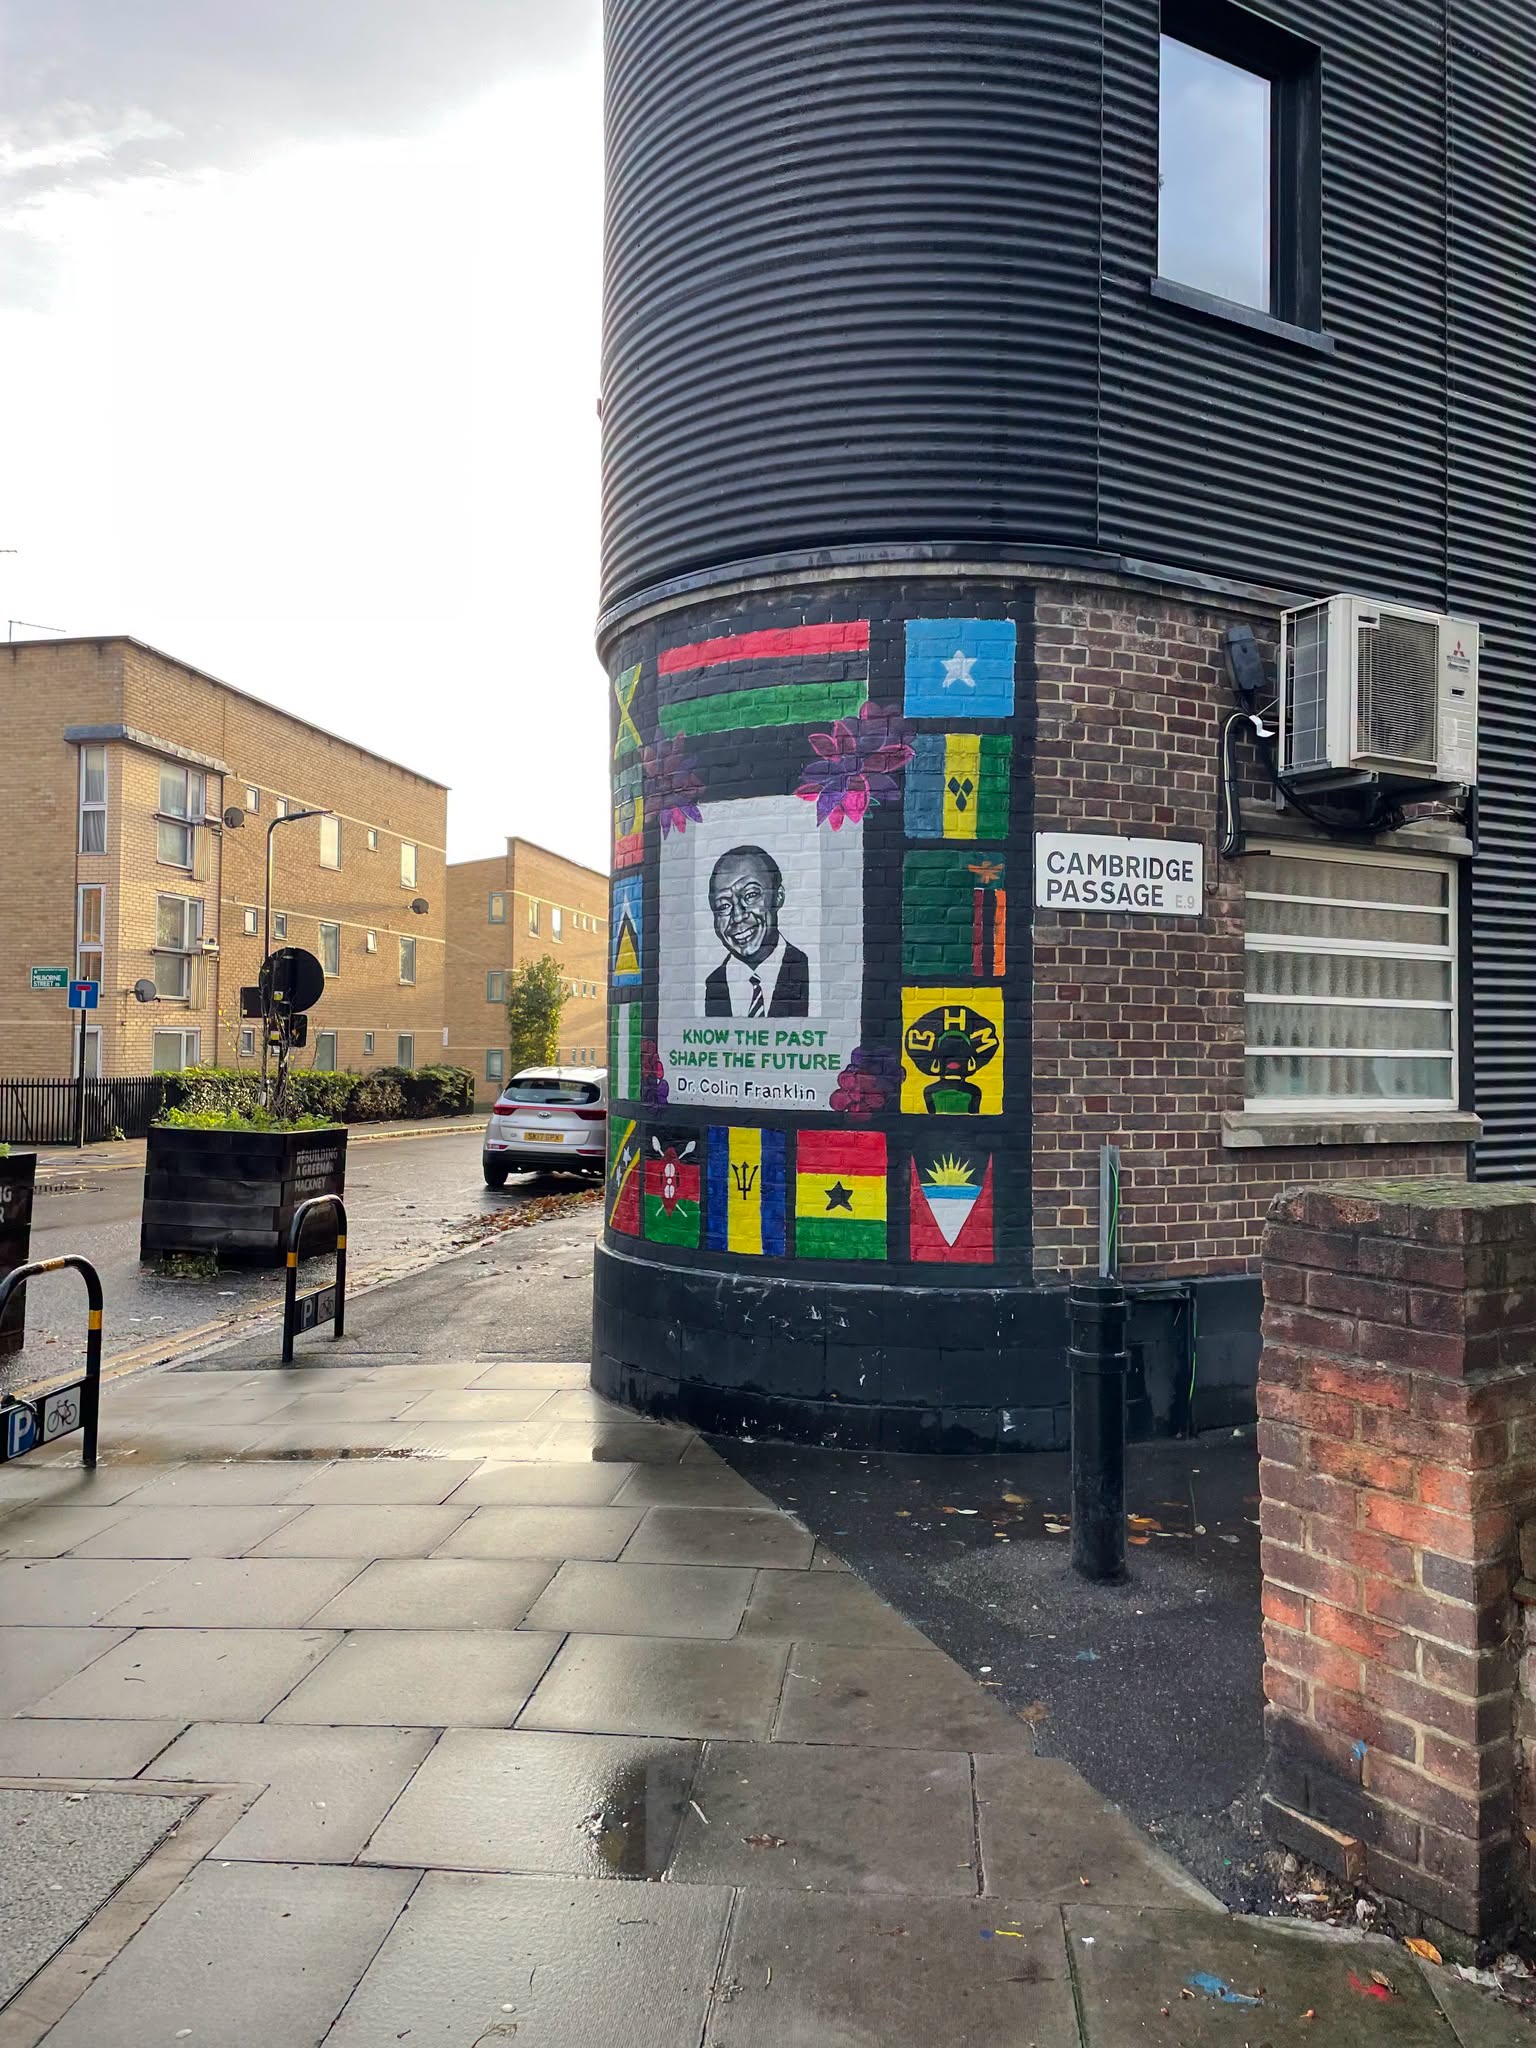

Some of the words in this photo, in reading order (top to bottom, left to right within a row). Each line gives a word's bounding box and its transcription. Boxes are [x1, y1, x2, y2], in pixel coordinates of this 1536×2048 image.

[1046, 850, 1194, 882] CAMBRIDGE
[1046, 878, 1164, 907] PASSAGE
[682, 1029, 730, 1046] KNOW
[734, 1030, 769, 1046] THE
[775, 1030, 828, 1047] PAST
[669, 1049, 718, 1067] SHAPE
[722, 1052, 756, 1068] THE
[761, 1053, 841, 1071] FUTURE
[677, 1078, 696, 1093] Dr.
[700, 1079, 739, 1096] Colin
[744, 1082, 817, 1101] Franklin
[294, 1175, 327, 1192] HACKNEY
[13, 1409, 33, 1453] P
